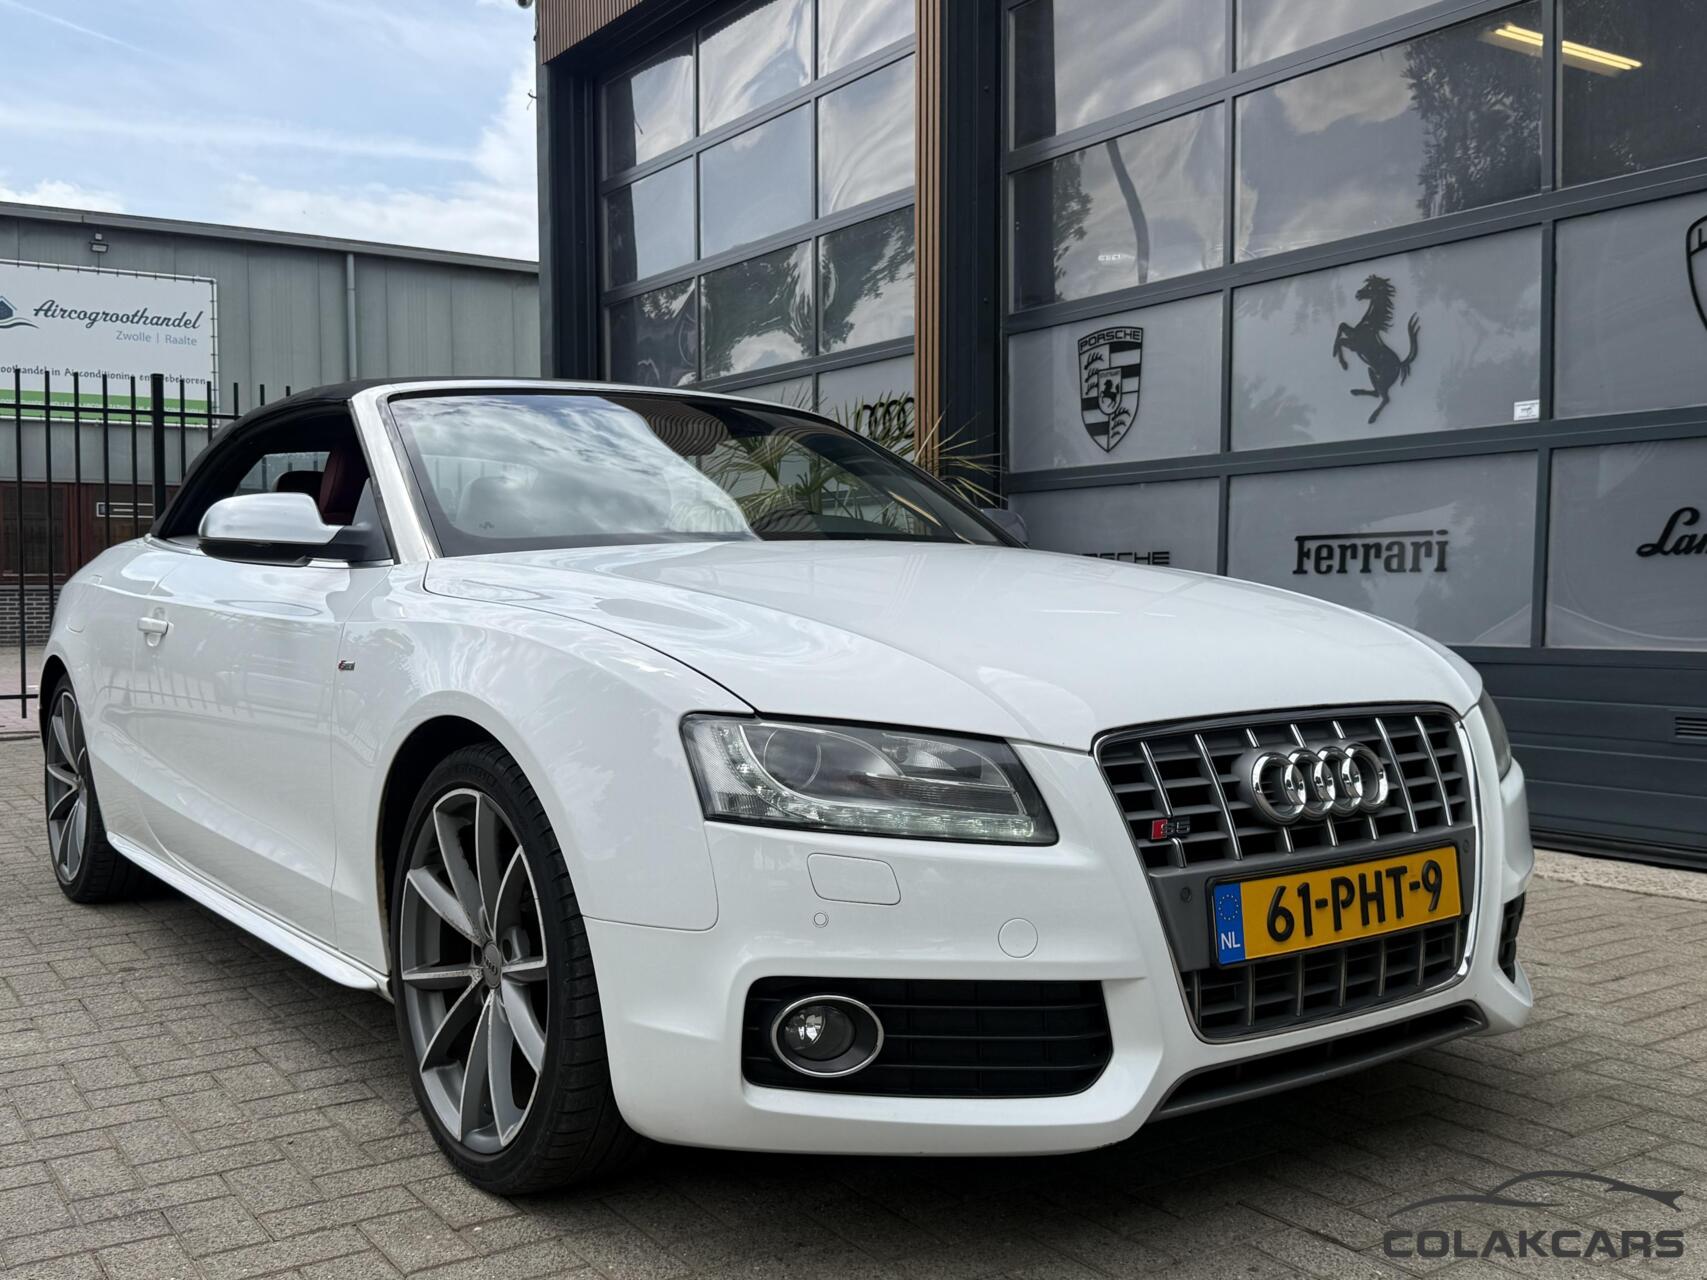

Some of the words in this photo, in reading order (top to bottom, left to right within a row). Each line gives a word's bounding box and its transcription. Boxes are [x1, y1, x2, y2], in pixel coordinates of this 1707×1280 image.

[33, 299, 204, 330] Aircogroothandel
[116, 330, 152, 343] Zwolle
[165, 334, 198, 346] Raalte
[1080, 330, 1141, 352] PORSCHE
[51, 367, 61, 376] in
[1292, 529, 1449, 575] Ferrari
[1267, 859, 1443, 943] 61-PHT-9
[1221, 932, 1241, 951] NL
